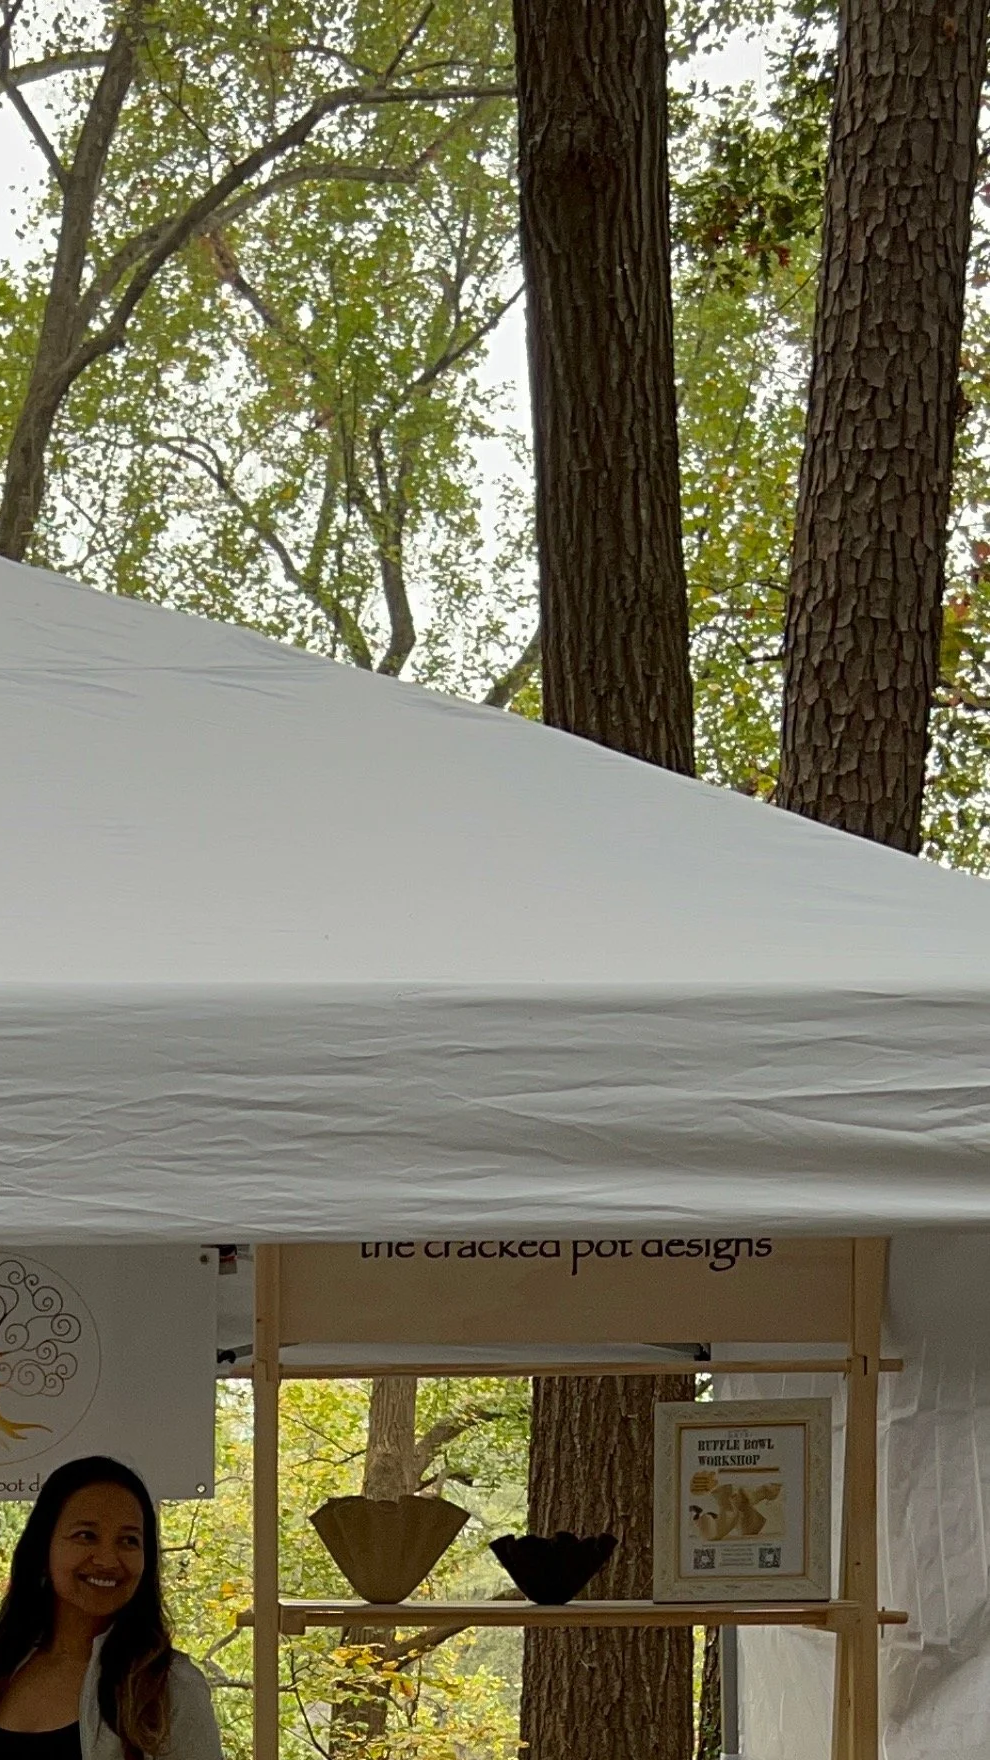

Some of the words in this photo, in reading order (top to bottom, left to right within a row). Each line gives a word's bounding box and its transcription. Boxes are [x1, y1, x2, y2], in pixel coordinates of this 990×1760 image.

[572, 1239, 633, 1276] pot
[697, 1439, 740, 1451] RUFFLE
[743, 1438, 774, 1450] BOWL
[697, 1454, 761, 1466] WORKSHOP
